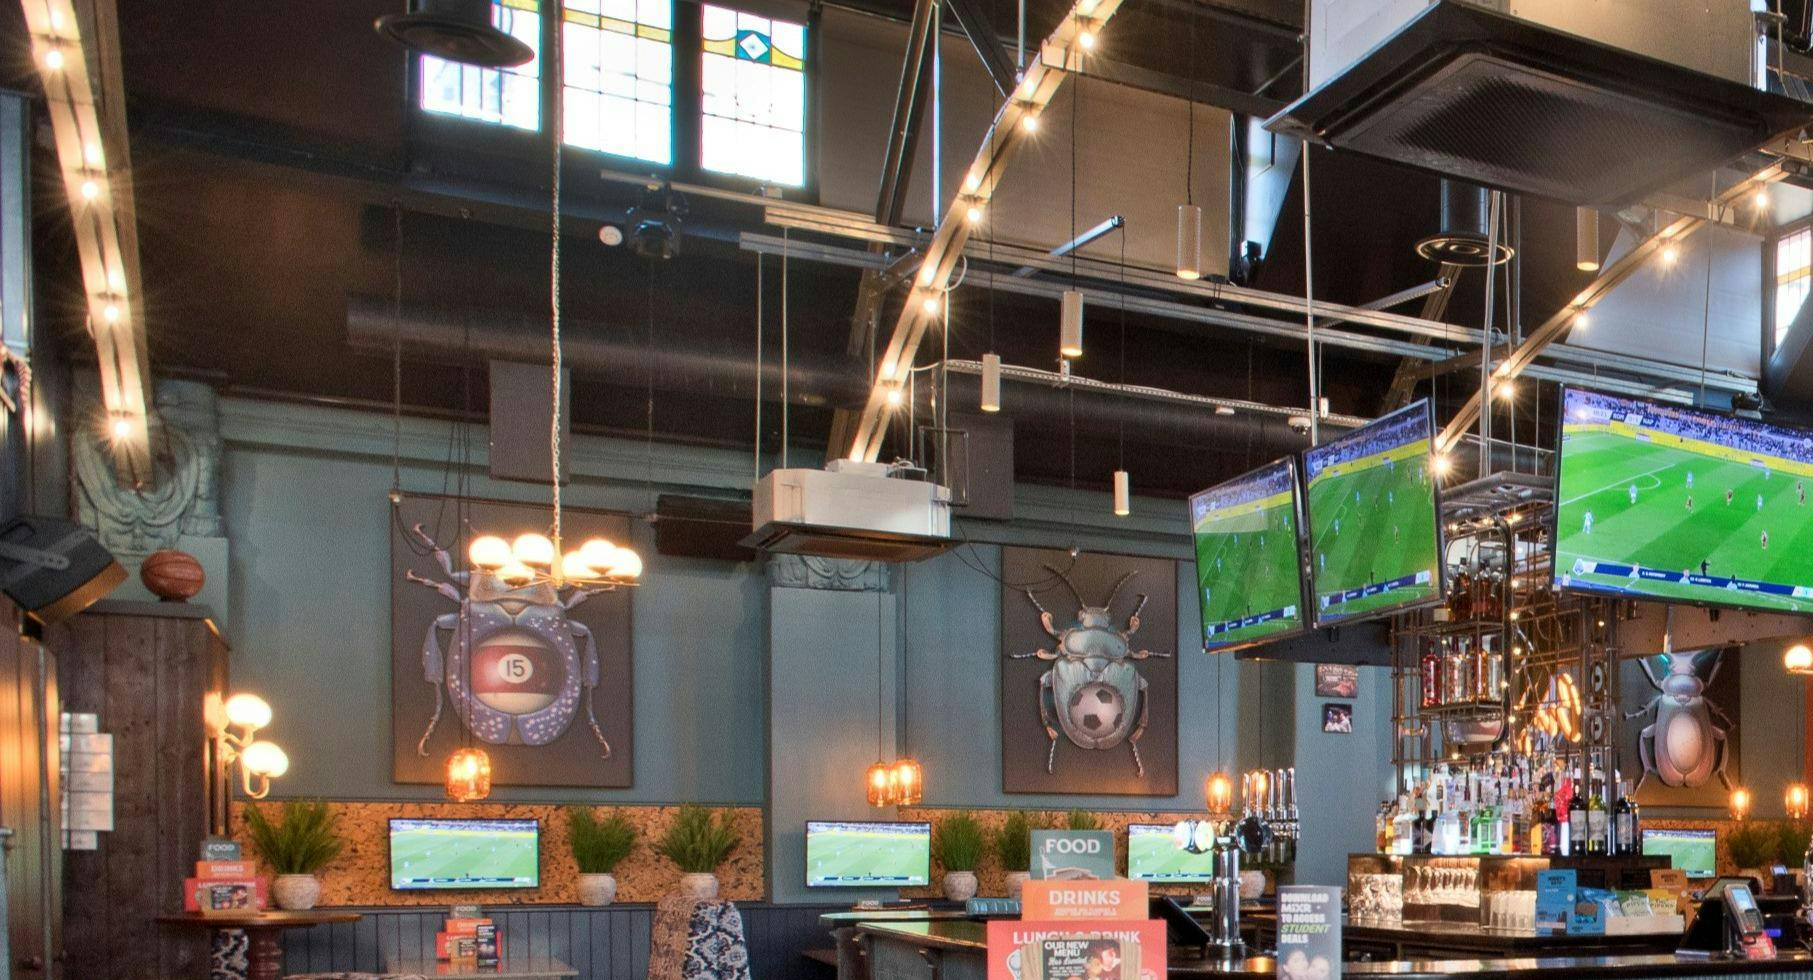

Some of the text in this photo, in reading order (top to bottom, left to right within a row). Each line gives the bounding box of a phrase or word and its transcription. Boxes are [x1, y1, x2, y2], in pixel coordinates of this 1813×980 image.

[506, 659, 525, 677] 15
[1045, 838, 1101, 854] FOOD
[1049, 890, 1121, 906] DRINKS
[1281, 893, 1329, 903] DOWNLOAD
[1281, 913, 1326, 923] TO ACCESS
[1281, 924, 1331, 934] STUDENT
[1281, 934, 1309, 943] DEALS
[1044, 941, 1089, 950] OUR NEW
[1053, 949, 1081, 957] MENU
